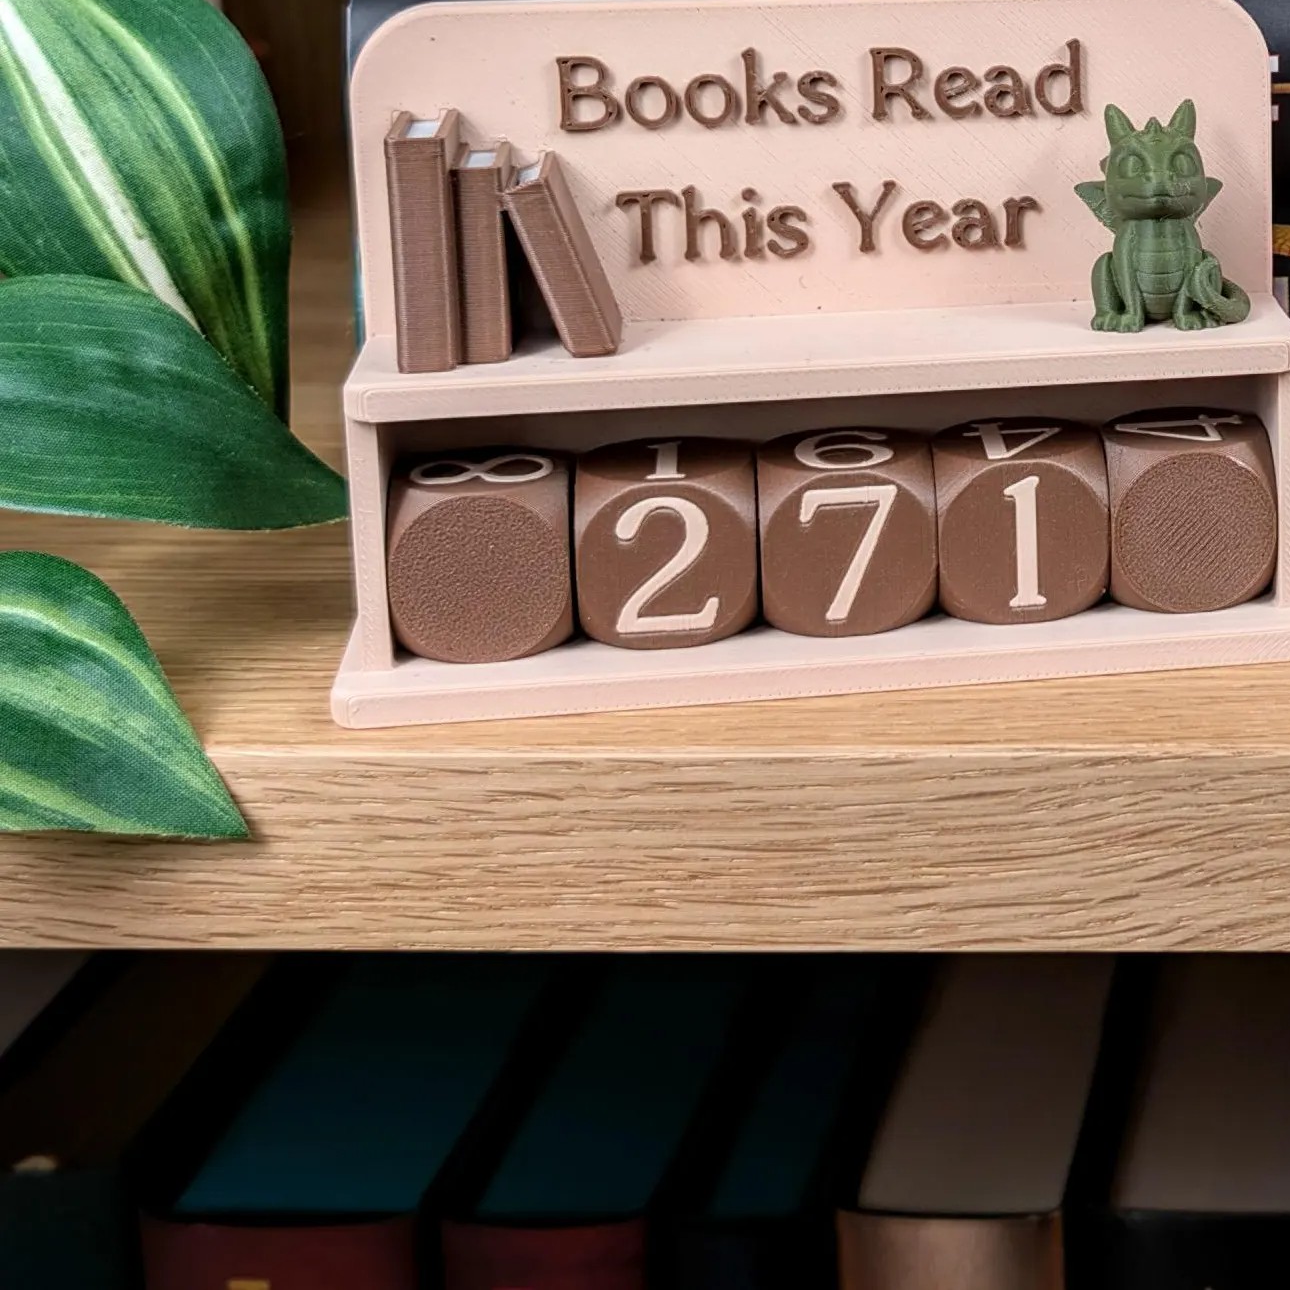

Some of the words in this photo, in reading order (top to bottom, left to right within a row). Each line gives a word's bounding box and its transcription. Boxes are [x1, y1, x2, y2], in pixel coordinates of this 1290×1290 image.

[554, 47, 844, 135] Books
[868, 39, 1087, 123] Read
[614, 184, 812, 270] This
[831, 179, 1043, 255] Year
